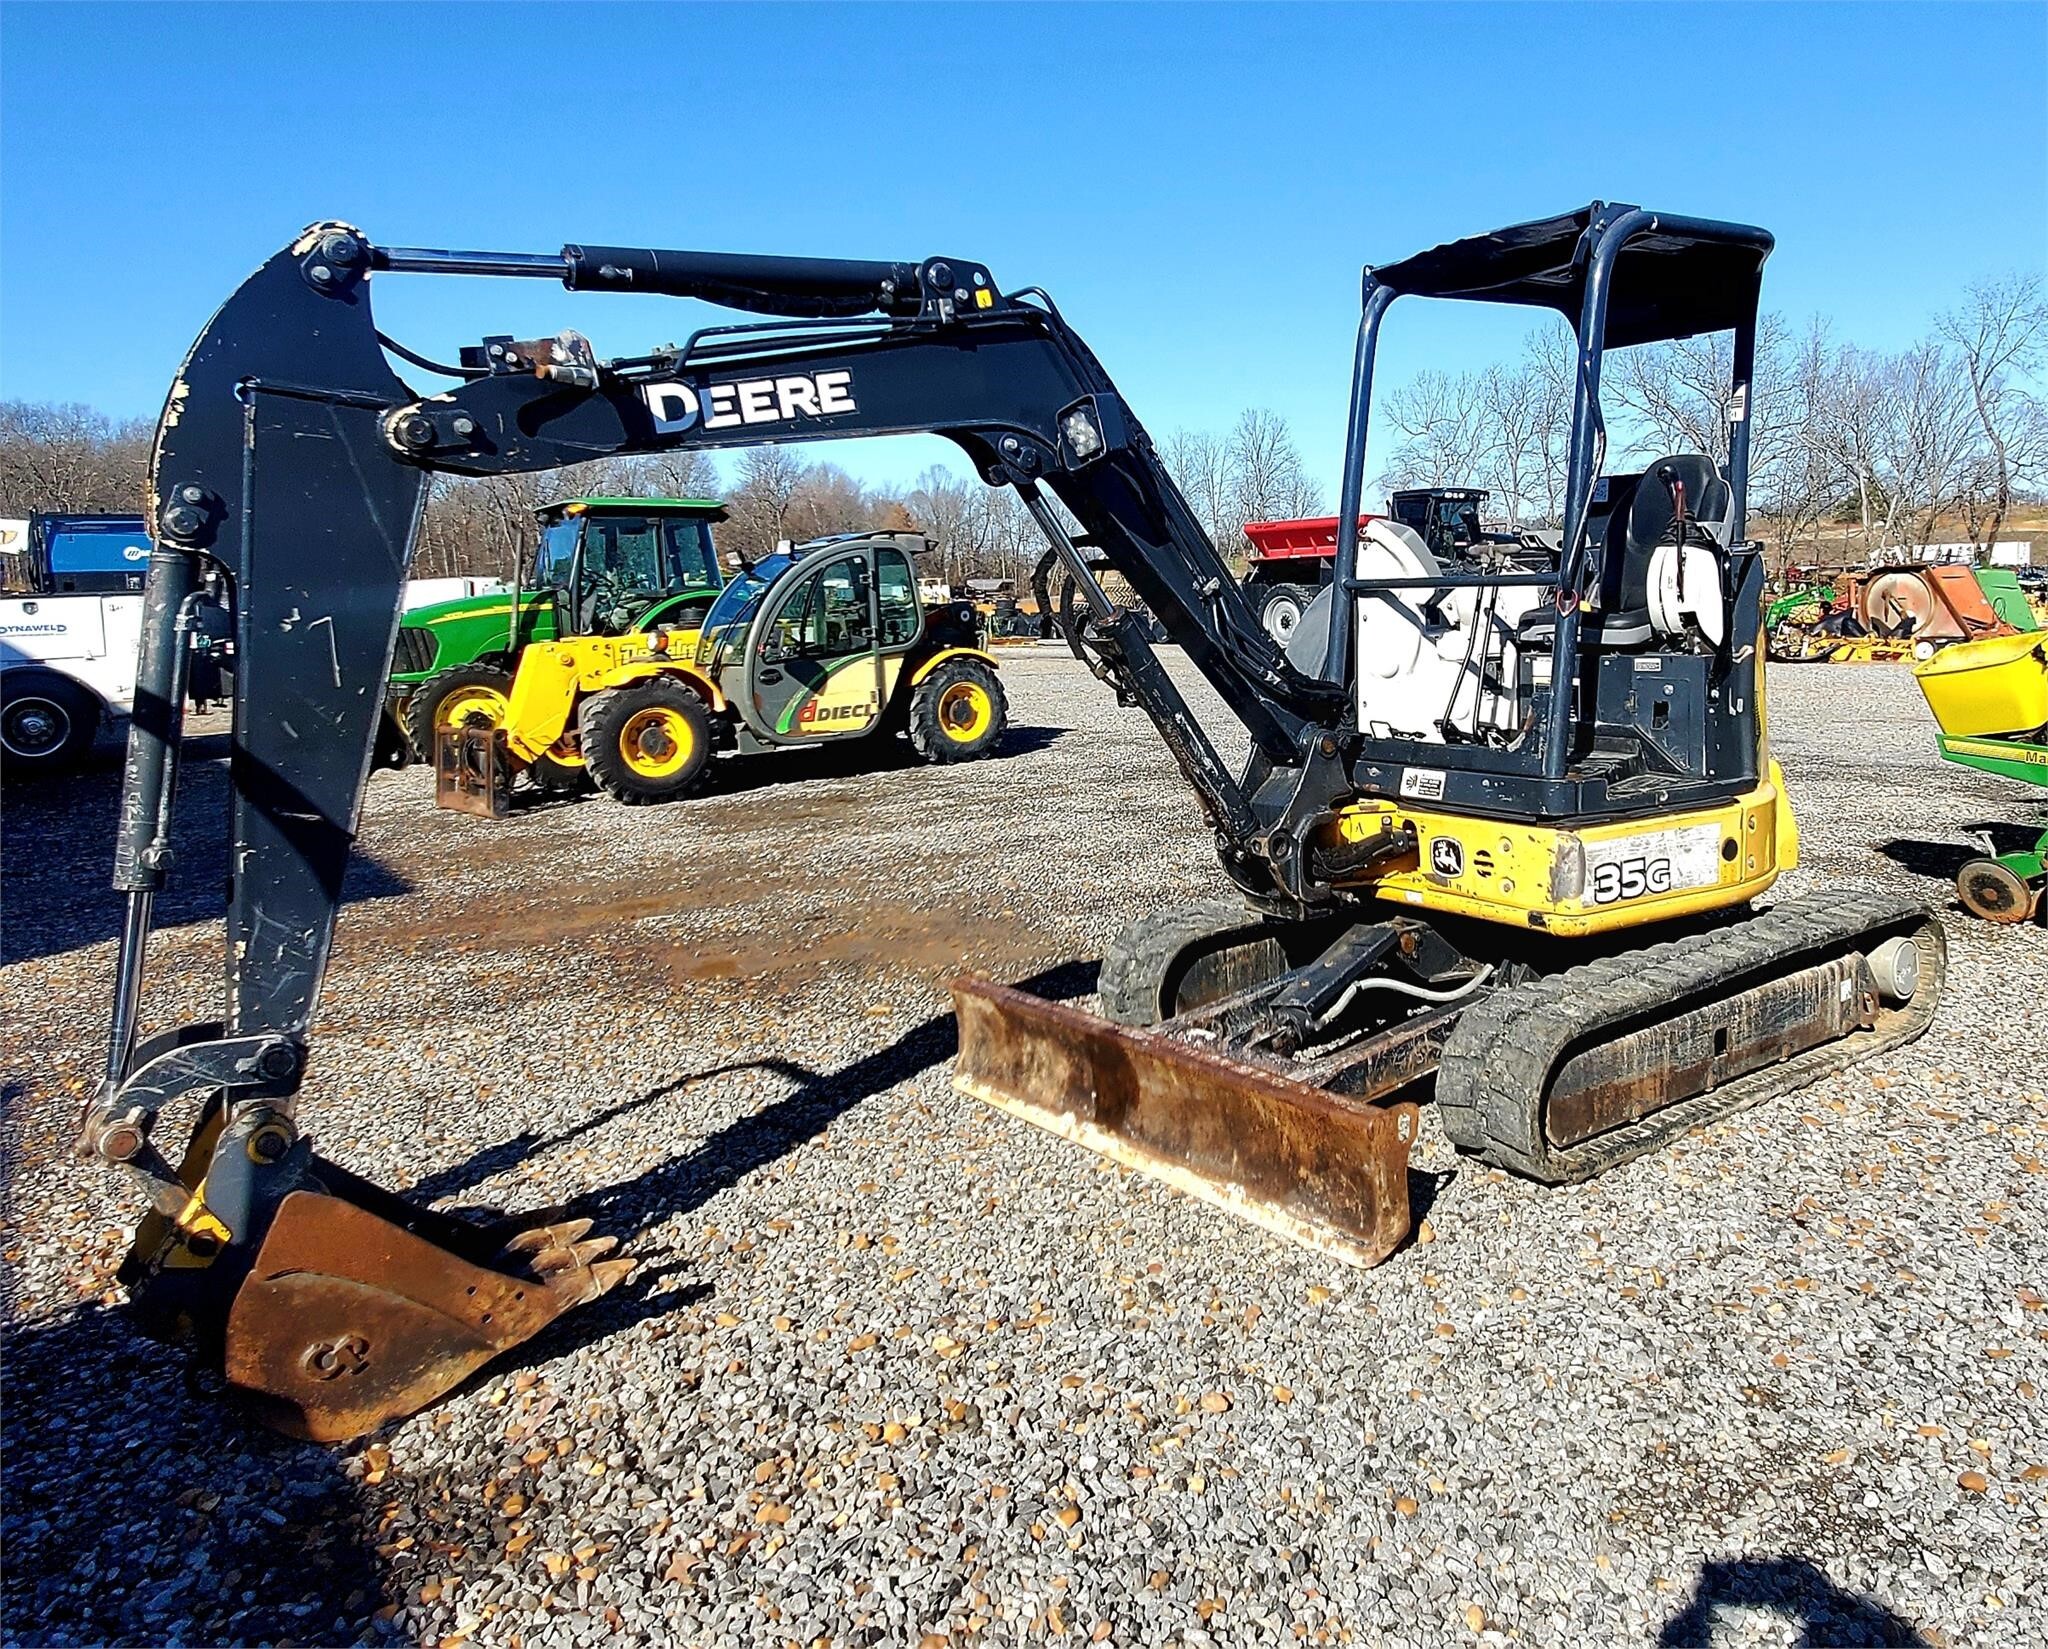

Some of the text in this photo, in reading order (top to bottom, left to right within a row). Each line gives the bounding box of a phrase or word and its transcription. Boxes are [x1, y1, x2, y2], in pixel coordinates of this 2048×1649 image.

[642, 370, 859, 435] DEERE
[0, 624, 67, 634] DYNAWELD
[817, 704, 871, 721] DIECI
[2025, 751, 2048, 765] Ma
[1594, 856, 1671, 904] 35G
